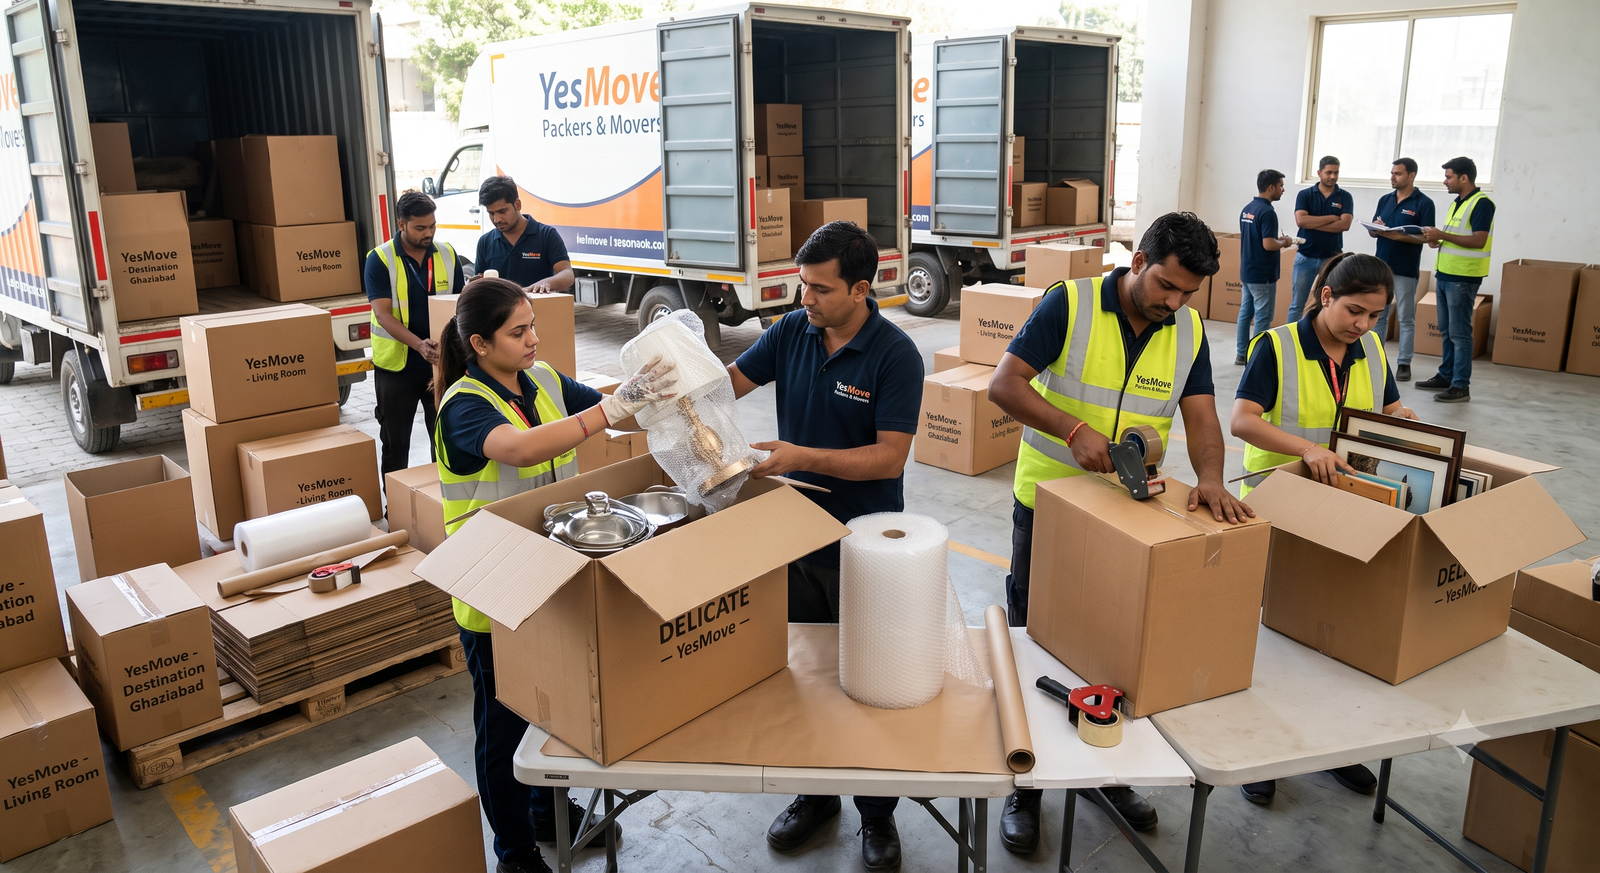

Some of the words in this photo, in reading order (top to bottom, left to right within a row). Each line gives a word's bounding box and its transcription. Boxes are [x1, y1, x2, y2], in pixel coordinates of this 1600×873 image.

[539, 65, 659, 110] YesMove
[543, 117, 592, 137] Packers
[596, 115, 606, 135] &
[610, 114, 660, 134] Movers
[121, 250, 178, 263] YesMove
[296, 249, 341, 261] YesMove
[128, 263, 179, 274] Destination
[301, 265, 322, 273] Living
[322, 263, 342, 271] Room
[130, 273, 176, 285] Ghaziabad
[978, 317, 1014, 331] YesMove
[1512, 326, 1546, 337] YesMove
[980, 329, 997, 339] Living
[997, 332, 1014, 340] Room
[245, 353, 305, 370] YesMove
[252, 371, 279, 383] Living
[280, 368, 307, 378] Room
[1136, 374, 1172, 389] YesMove
[836, 380, 871, 399] YesMove
[925, 411, 957, 426] YesMove
[927, 422, 962, 436] Destination
[927, 431, 959, 445] Ghaziabad
[297, 477, 346, 493] YesMove
[300, 493, 327, 505] Living
[327, 488, 354, 499] Room
[1446, 581, 1487, 604] YesMo
[660, 585, 750, 645] DELICATE
[676, 622, 736, 659] YesMove
[124, 651, 190, 679] YesMove
[123, 664, 206, 697] Destination
[130, 678, 205, 713] Ghaziabad
[7, 758, 79, 789] YesMove
[3, 786, 52, 810] Living
[54, 768, 100, 792] Room
